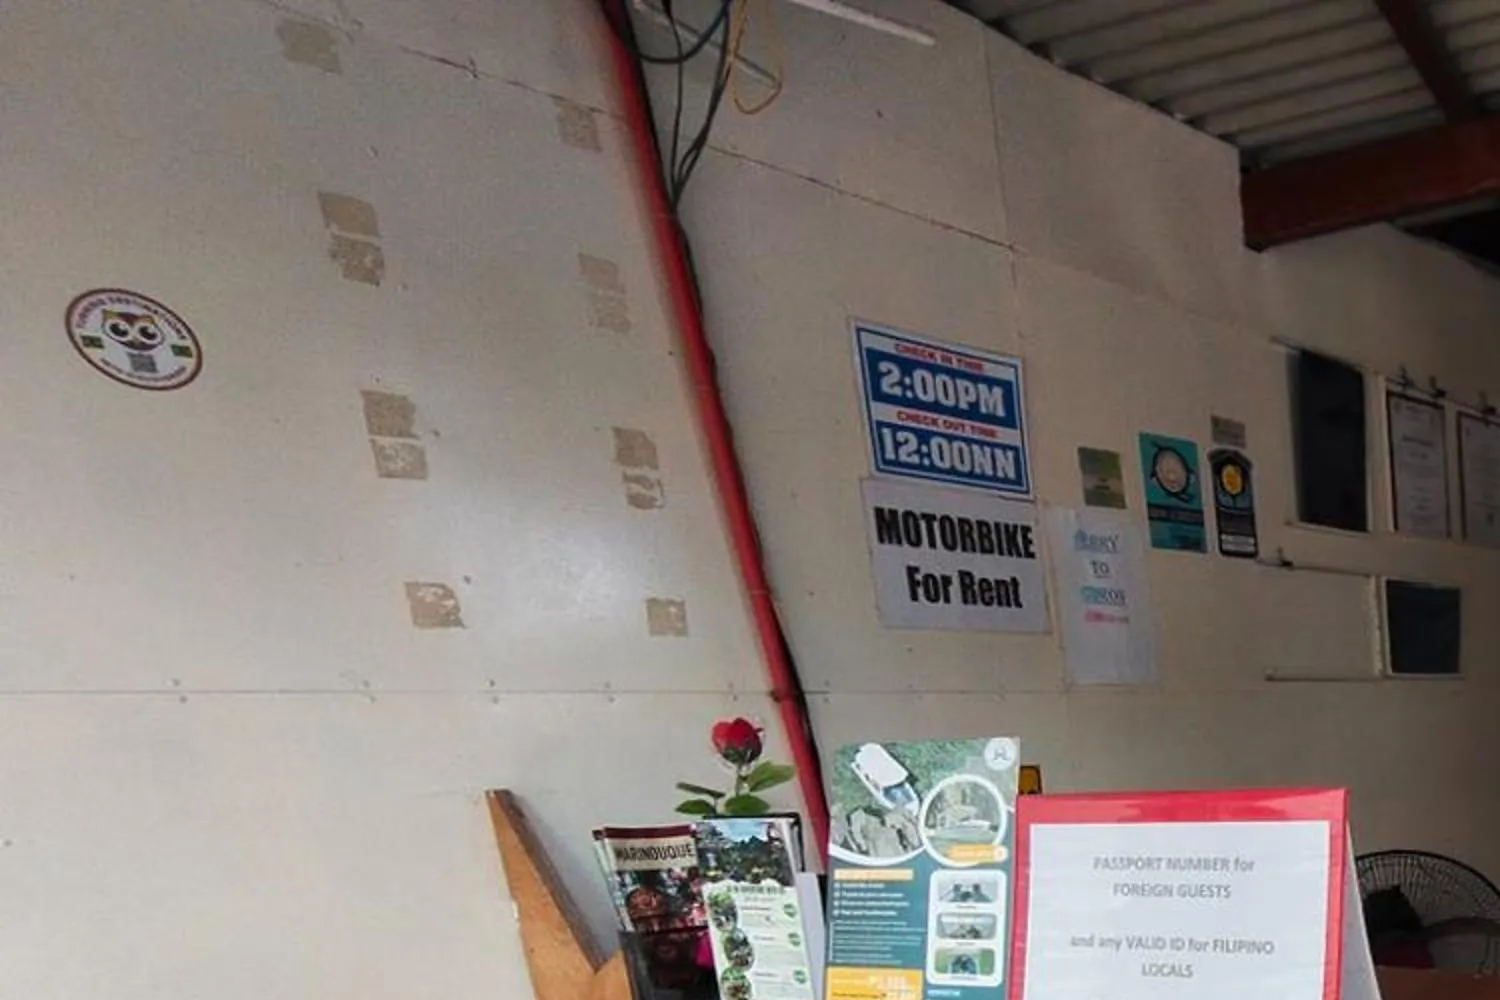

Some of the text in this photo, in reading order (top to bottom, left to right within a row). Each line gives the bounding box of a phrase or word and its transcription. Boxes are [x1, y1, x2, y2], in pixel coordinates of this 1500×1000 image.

[878, 361, 1006, 417] 2:00PM
[879, 427, 1017, 479] 12:00NN
[874, 506, 1036, 559] MOTORBIKE
[906, 565, 1023, 608] For Rent
[1094, 857, 1255, 872] PASSPORT NUMBER for
[1113, 883, 1232, 899] FOREIGN GUESTS
[1070, 935, 1275, 955] and any VALID ID for FILIPINO
[1141, 963, 1194, 978] LOCALS
